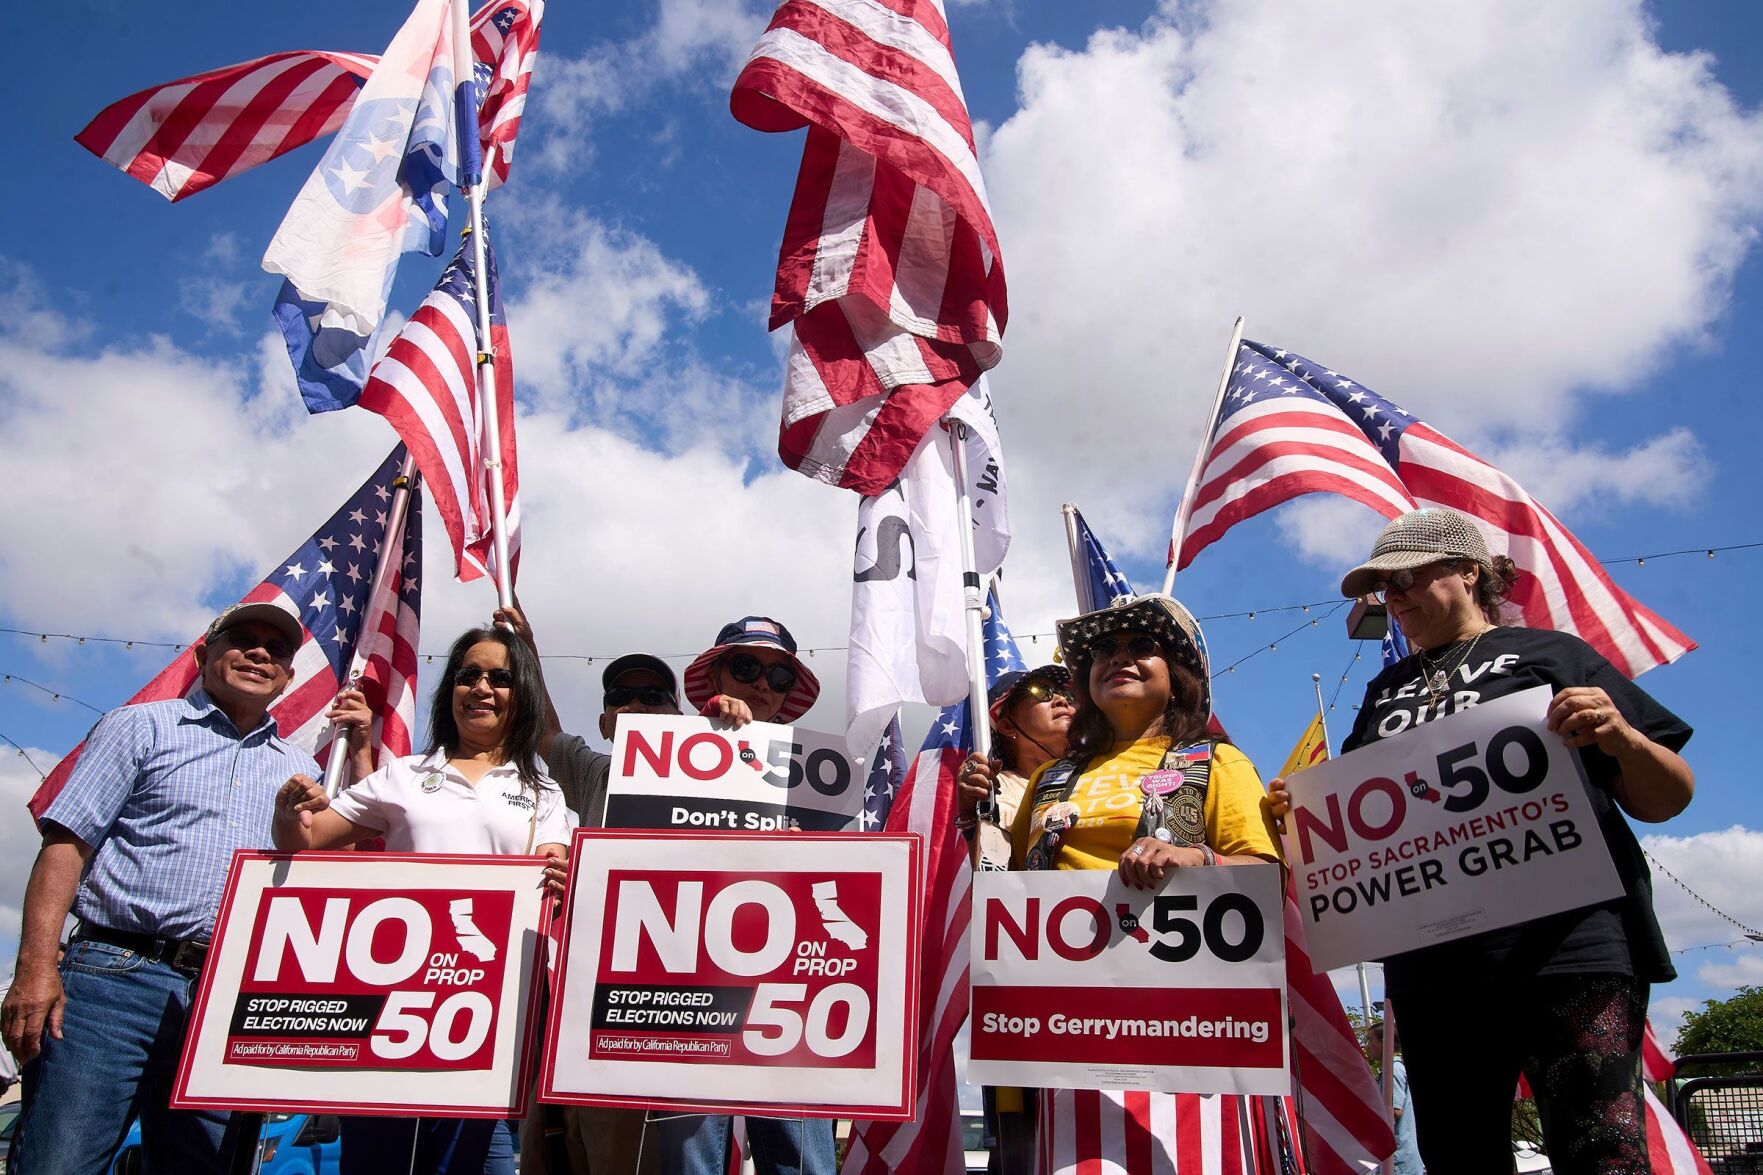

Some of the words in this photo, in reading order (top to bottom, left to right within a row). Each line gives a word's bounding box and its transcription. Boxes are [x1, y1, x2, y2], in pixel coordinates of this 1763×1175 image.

[1378, 691, 1480, 738] OUR
[622, 730, 733, 780] NO
[742, 751, 754, 759] on
[762, 740, 850, 796] 50
[502, 792, 535, 809] AMERICA
[508, 800, 530, 811] FIRST
[1294, 777, 1406, 866] NO
[1413, 782, 1426, 793] on
[1437, 726, 1549, 813] 50
[671, 808, 737, 828] Don't
[744, 812, 799, 831] Split
[1307, 858, 1361, 890] STOP
[1370, 794, 1569, 870] SACRAMENTO'S
[1310, 859, 1448, 923] POWER
[1458, 819, 1582, 876] GRAB
[611, 880, 796, 976] NO
[984, 896, 1111, 961] NO
[1122, 918, 1136, 927] on
[1148, 893, 1264, 962] 50
[253, 897, 432, 986] NO
[798, 942, 826, 957] ON
[430, 953, 458, 967] ON
[793, 958, 857, 976] PROP
[424, 969, 484, 986] PROP
[248, 1000, 288, 1013] STOP
[289, 1000, 347, 1013] RIGGED
[608, 990, 651, 1005] STOP
[652, 992, 713, 1006] RIGGED
[243, 1017, 328, 1031] ELECTIONS
[328, 1019, 368, 1032] NOW
[371, 992, 492, 1061] 50
[606, 1010, 694, 1025] ELECTIONS
[696, 1012, 737, 1026] NOW
[742, 982, 870, 1058] 50
[983, 1013, 1040, 1037] Stop
[1049, 1014, 1268, 1042] Gerrymandering
[233, 1044, 244, 1054] Ad
[243, 1044, 258, 1056] paid
[258, 1045, 266, 1054] for
[267, 1045, 275, 1056] by
[276, 1045, 304, 1055] California
[304, 1045, 339, 1057] Republican
[339, 1046, 356, 1058] Party
[599, 1038, 608, 1048] Ad
[608, 1038, 624, 1051] paid
[624, 1039, 634, 1049] for
[634, 1039, 642, 1052] by
[643, 1040, 672, 1050] California
[673, 1040, 709, 1053] Republican
[710, 1041, 728, 1054] Party
